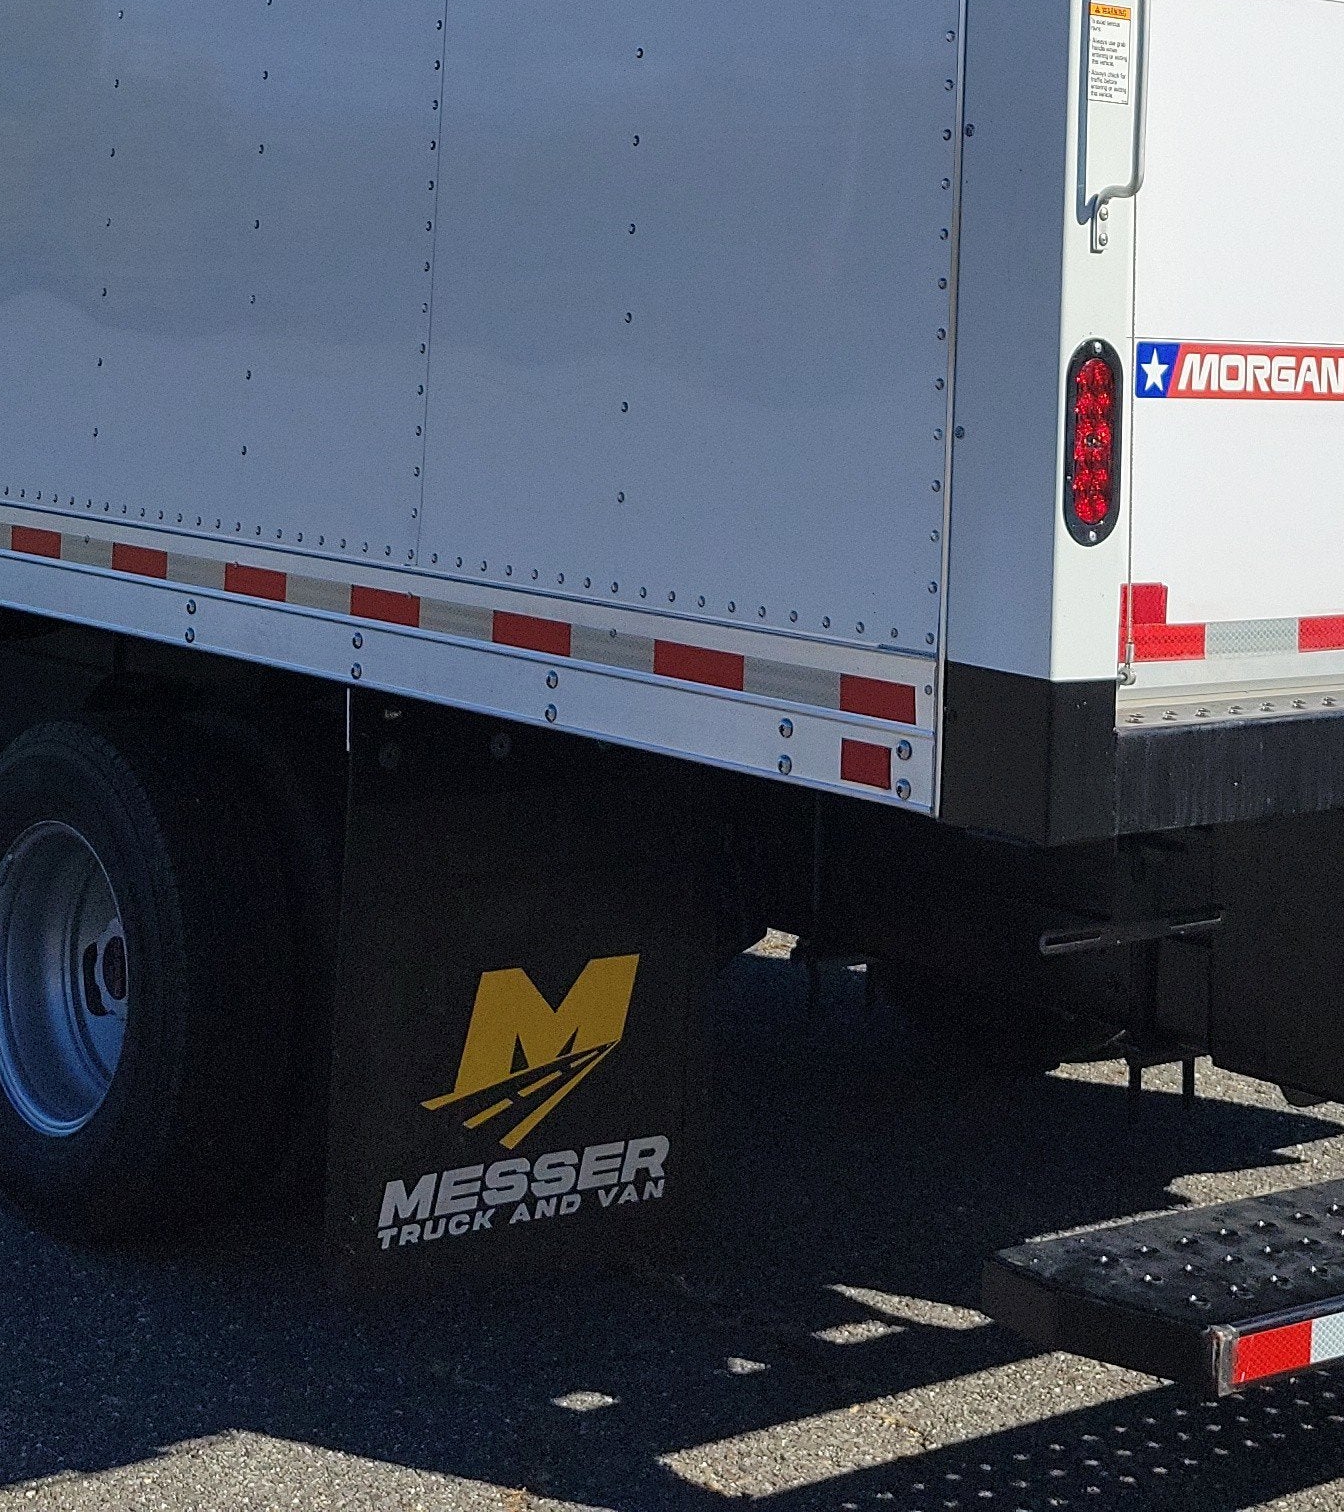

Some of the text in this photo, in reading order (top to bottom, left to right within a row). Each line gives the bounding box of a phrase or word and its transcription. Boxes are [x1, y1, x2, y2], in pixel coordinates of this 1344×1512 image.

[377, 1135, 670, 1228] MESSER
[377, 1179, 665, 1250] TRUCK AND VAN
